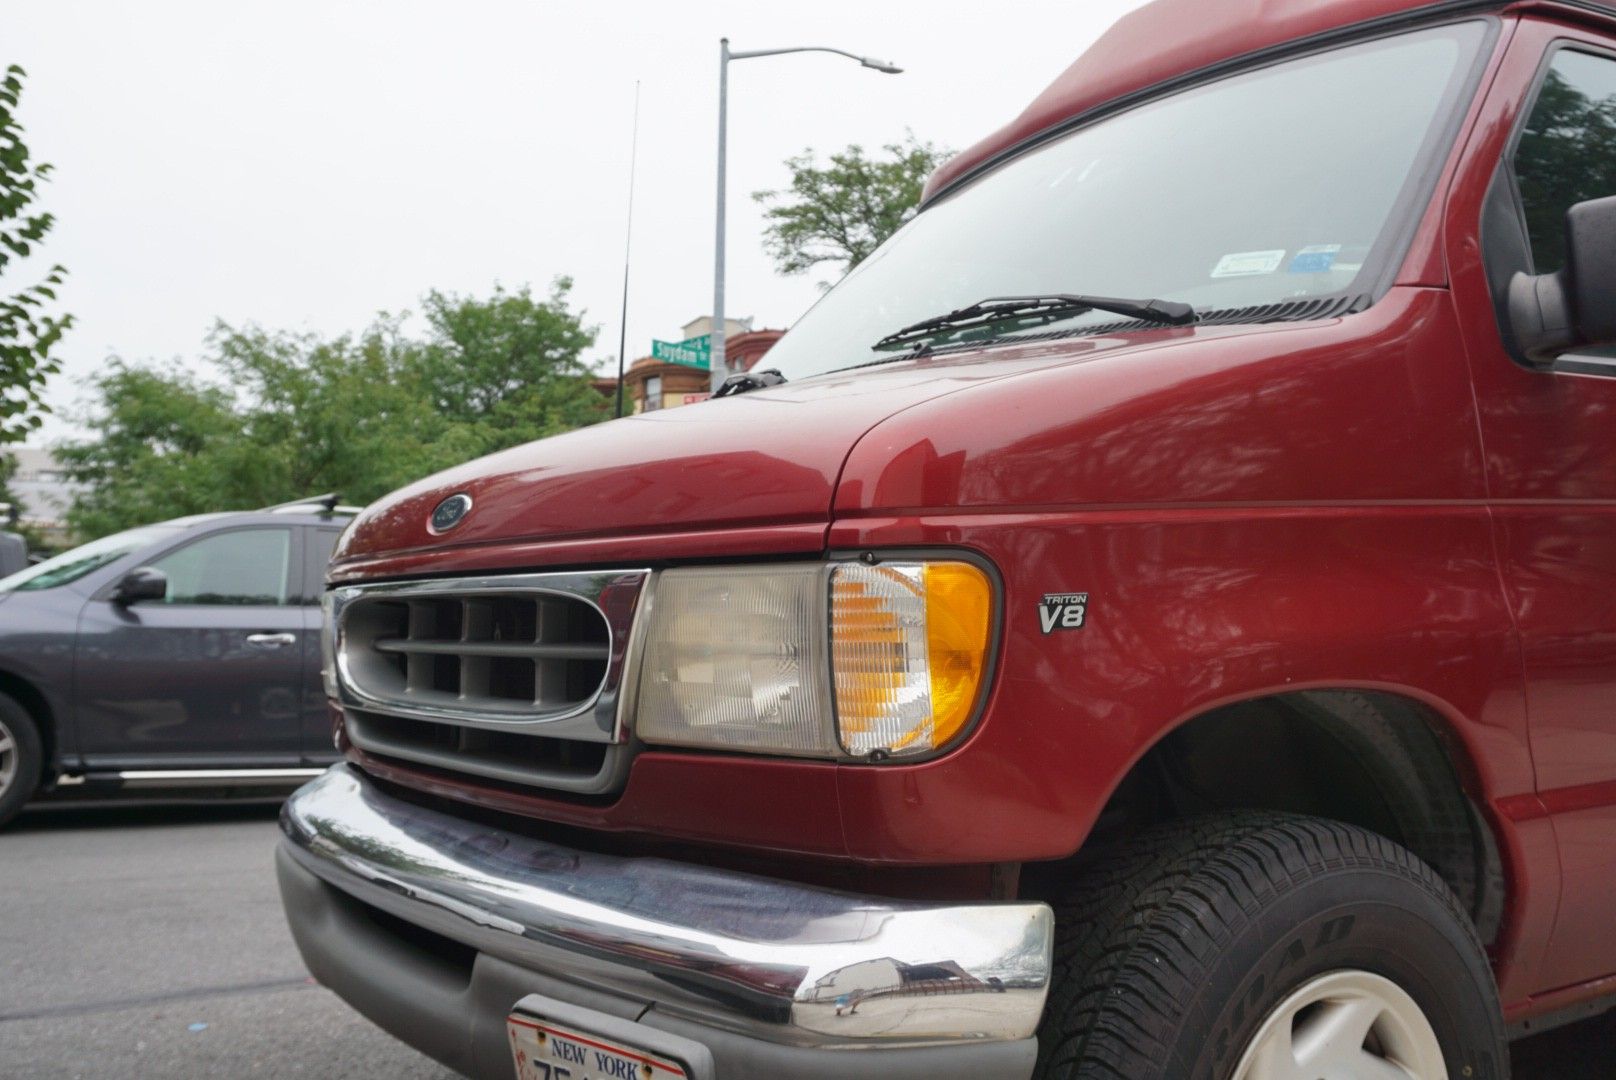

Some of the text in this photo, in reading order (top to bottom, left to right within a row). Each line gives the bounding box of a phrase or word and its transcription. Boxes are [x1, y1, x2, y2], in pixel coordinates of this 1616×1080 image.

[656, 341, 698, 364] Suydam
[1044, 595, 1087, 604] TRITON
[1039, 605, 1085, 633] V8
[551, 1037, 588, 1066] NEW
[594, 1051, 639, 1080] YORK
